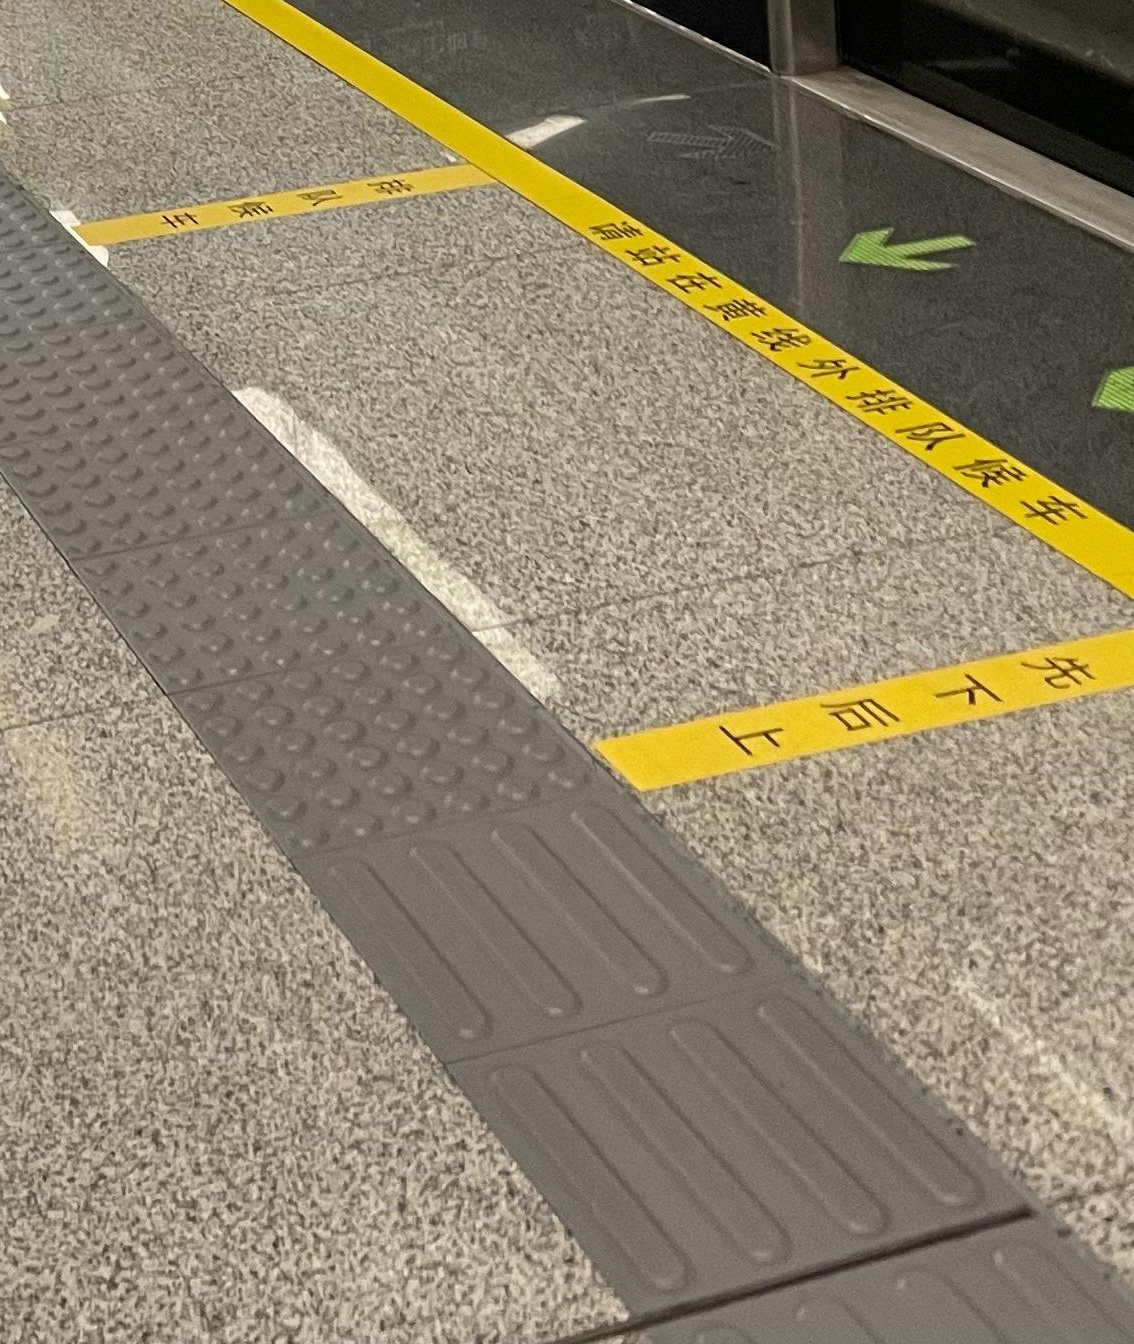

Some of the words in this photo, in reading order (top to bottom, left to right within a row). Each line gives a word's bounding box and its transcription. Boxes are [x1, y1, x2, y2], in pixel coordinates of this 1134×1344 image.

[589, 219, 1089, 526] 请站在黄线外排队候车
[719, 656, 1096, 756] 先下后上
